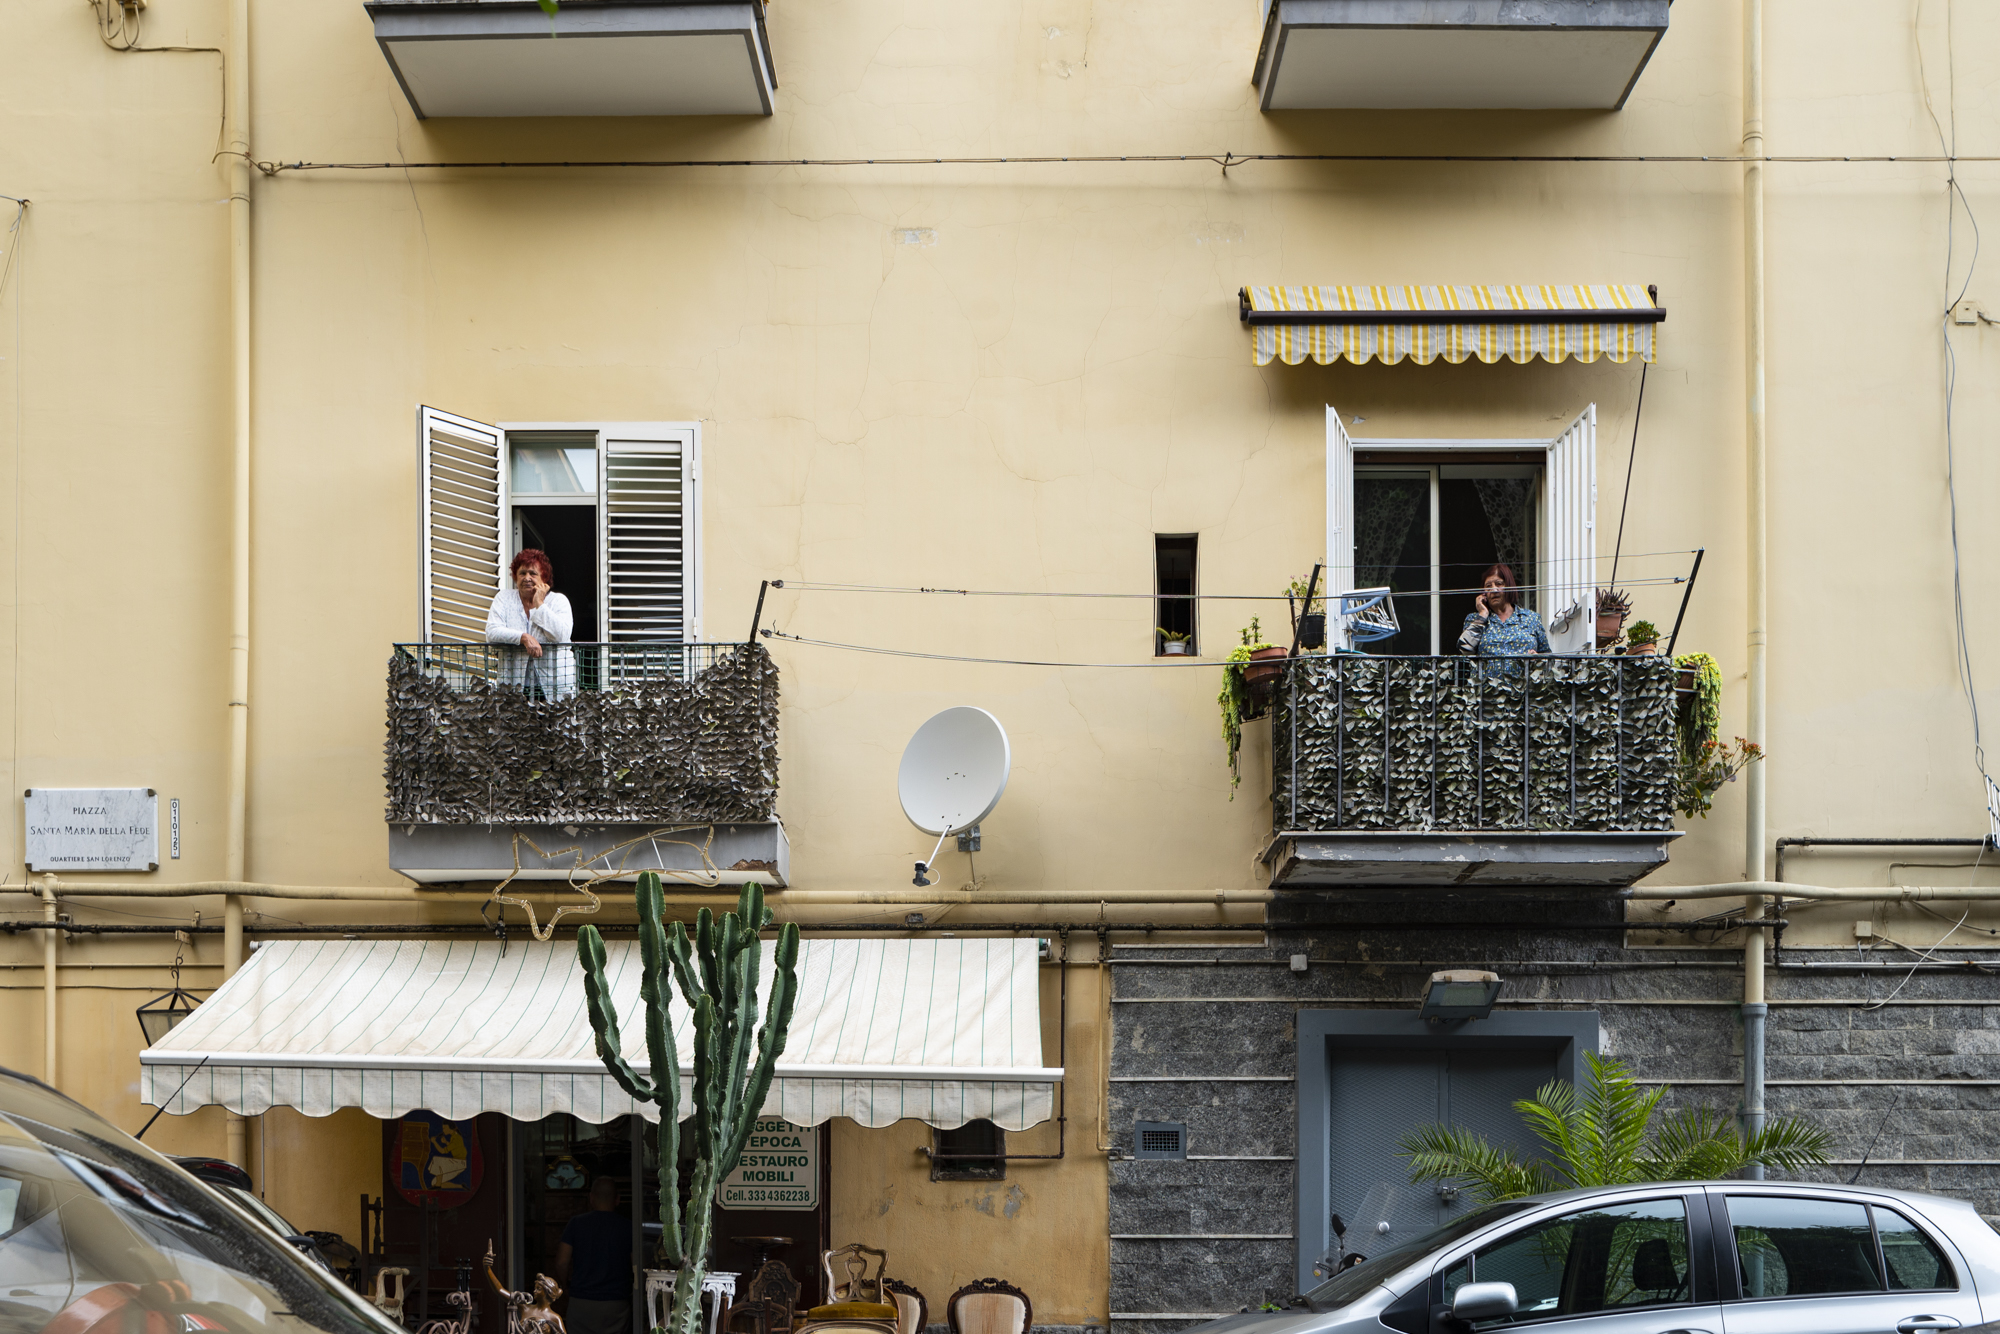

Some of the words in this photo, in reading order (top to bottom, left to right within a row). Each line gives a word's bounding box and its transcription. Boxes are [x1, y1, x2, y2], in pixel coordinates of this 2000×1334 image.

[73, 807, 107, 815] PIAZZA
[99, 826, 126, 835] DELLA
[739, 1156, 809, 1167] ESTAURO
[742, 1170, 794, 1182] MOBILI
[726, 1189, 747, 1201] Cell.
[748, 1190, 766, 1201] 333
[767, 1190, 810, 1201] 4362238
